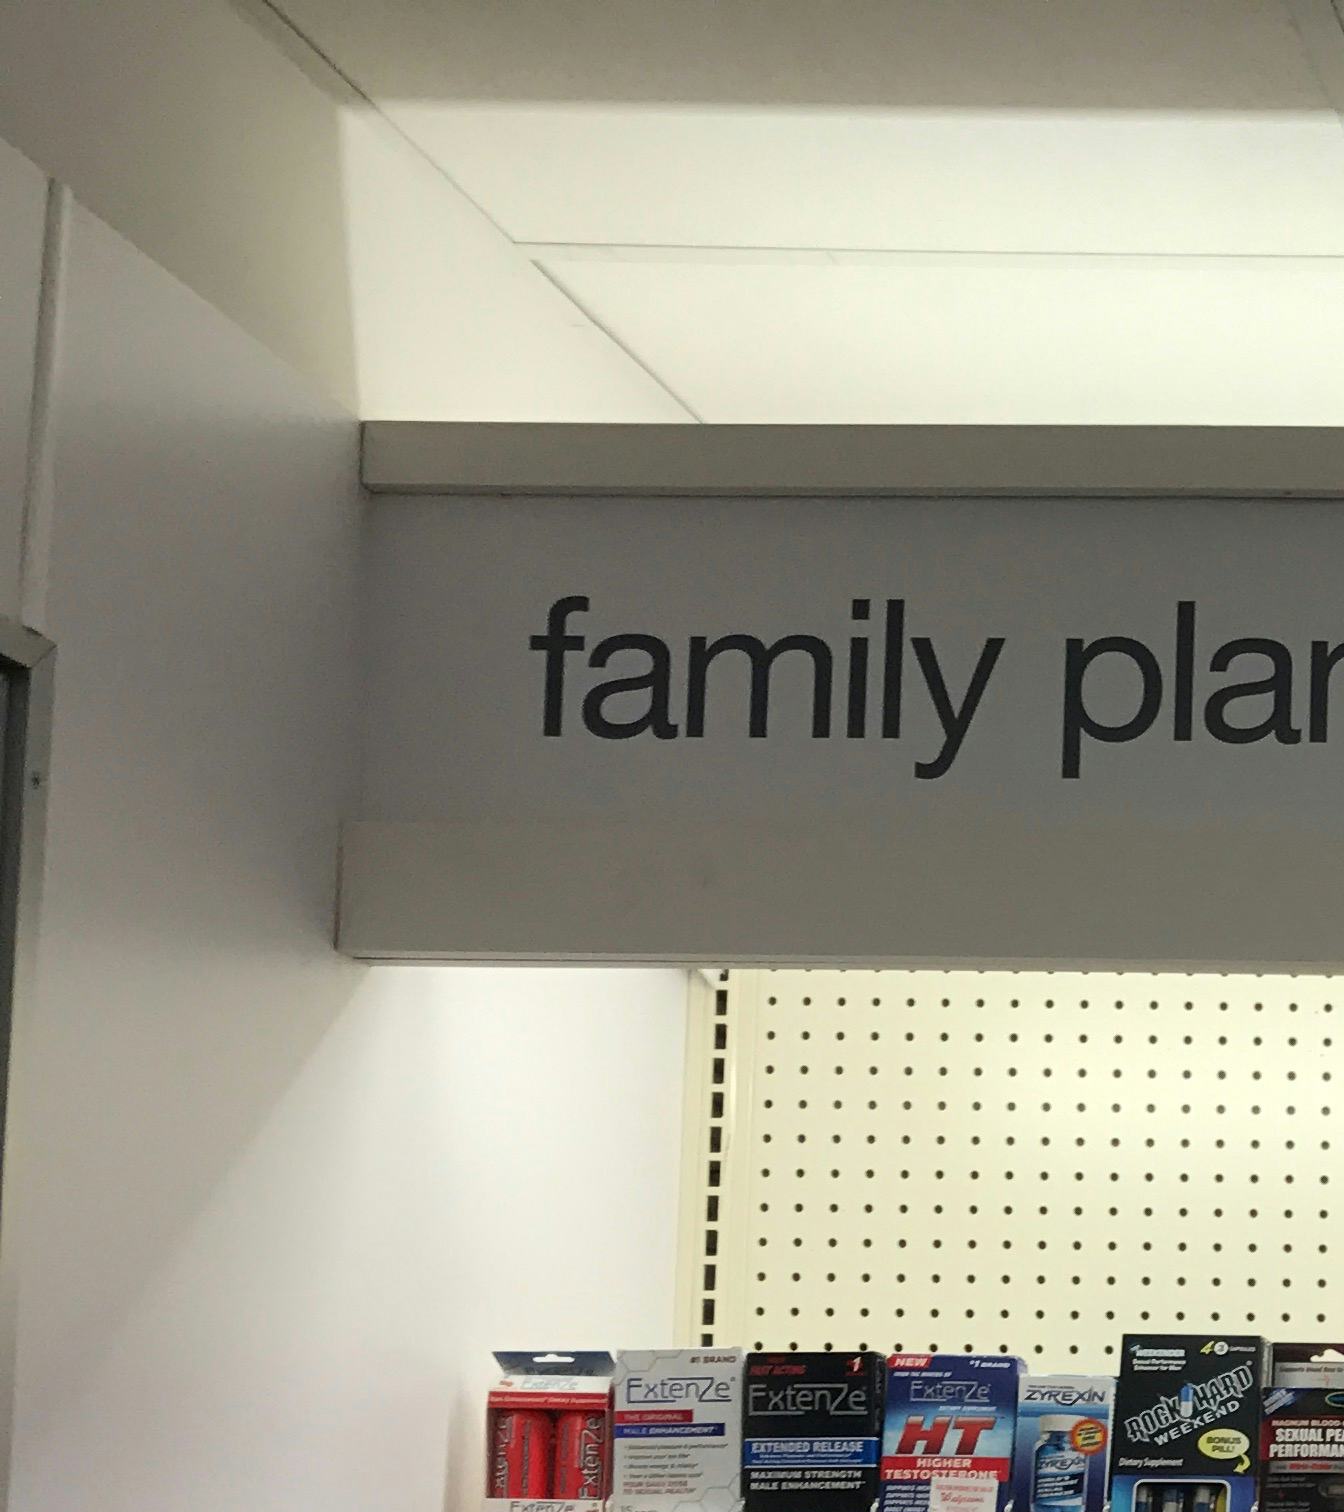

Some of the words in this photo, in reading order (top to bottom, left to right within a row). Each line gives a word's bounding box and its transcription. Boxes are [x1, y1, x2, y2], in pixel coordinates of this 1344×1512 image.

[529, 597, 1005, 779] family
[892, 1356, 930, 1368] NEW
[1024, 1387, 1106, 1404] ZYREXIN
[1154, 1400, 1239, 1446] WEEKEND
[898, 1416, 998, 1456] HT
[1207, 1437, 1241, 1445] BONUS
[1275, 1428, 1319, 1442] SEXUAL
[750, 1440, 816, 1453] EXTENDED
[819, 1440, 864, 1453] RELEASE
[916, 1457, 972, 1469] HIGHER
[750, 1470, 808, 1480] MAXIMUM
[810, 1470, 862, 1480] STRENGTH
[884, 1469, 999, 1481] TESTOSTERONE
